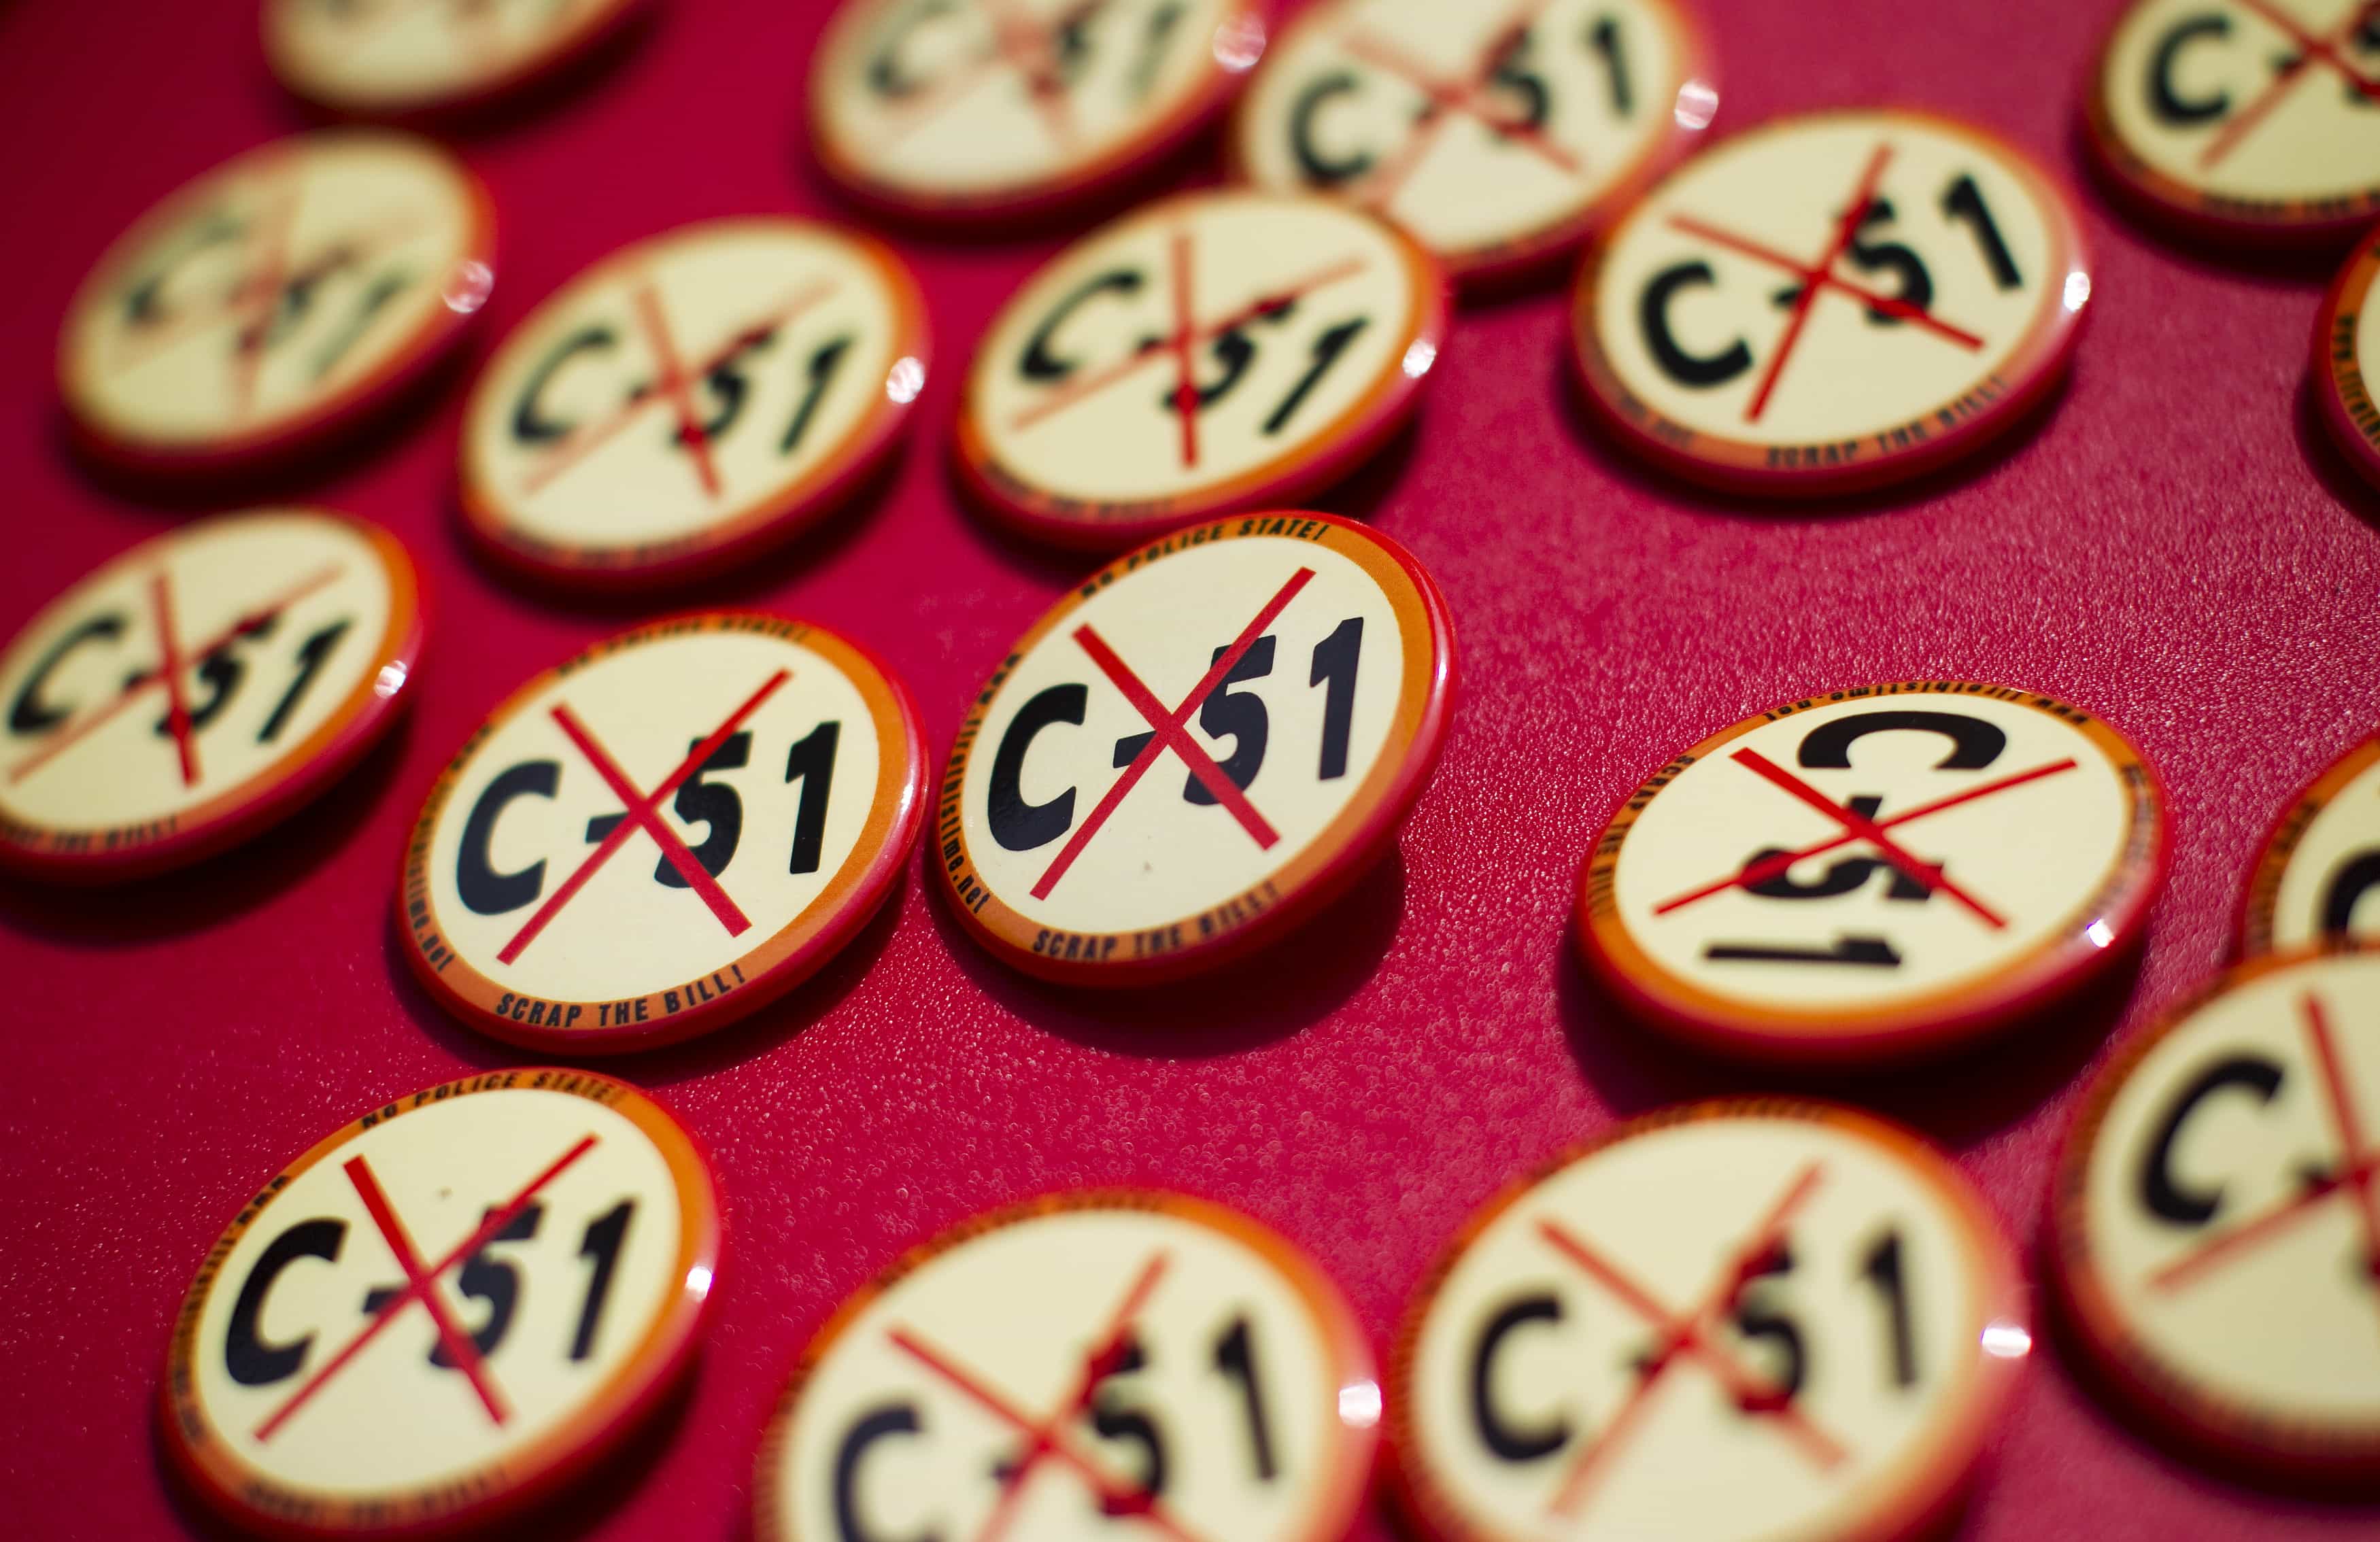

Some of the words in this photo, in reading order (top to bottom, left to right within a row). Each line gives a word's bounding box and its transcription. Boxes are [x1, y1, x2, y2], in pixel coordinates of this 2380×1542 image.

[1288, 14, 1635, 189] C-51
[2145, 5, 2380, 129] C-
[1016, 269, 1369, 437] C-51
[1639, 173, 2023, 390] C-51
[510, 325, 854, 456] C-51
[1128, 524, 1223, 570] POLICE
[1238, 518, 1329, 541] STATE!
[7, 612, 352, 743] C-51
[987, 616, 1364, 851] C-51
[456, 721, 840, 916] C-51
[1628, 755, 1695, 811] SCRAP
[1702, 710, 2008, 965] C-51
[496, 993, 582, 1028] SCRAP
[598, 997, 649, 1027] THE
[664, 963, 747, 1014] BILL!
[1033, 928, 1118, 963] SCRAP
[1133, 923, 1181, 957] THE
[361, 1103, 398, 1129] NO
[413, 1072, 521, 1107] POLICE
[224, 1197, 639, 1388] C-51
[1467, 1226, 1918, 1465] C-51
[831, 1307, 1281, 1542] C-51
